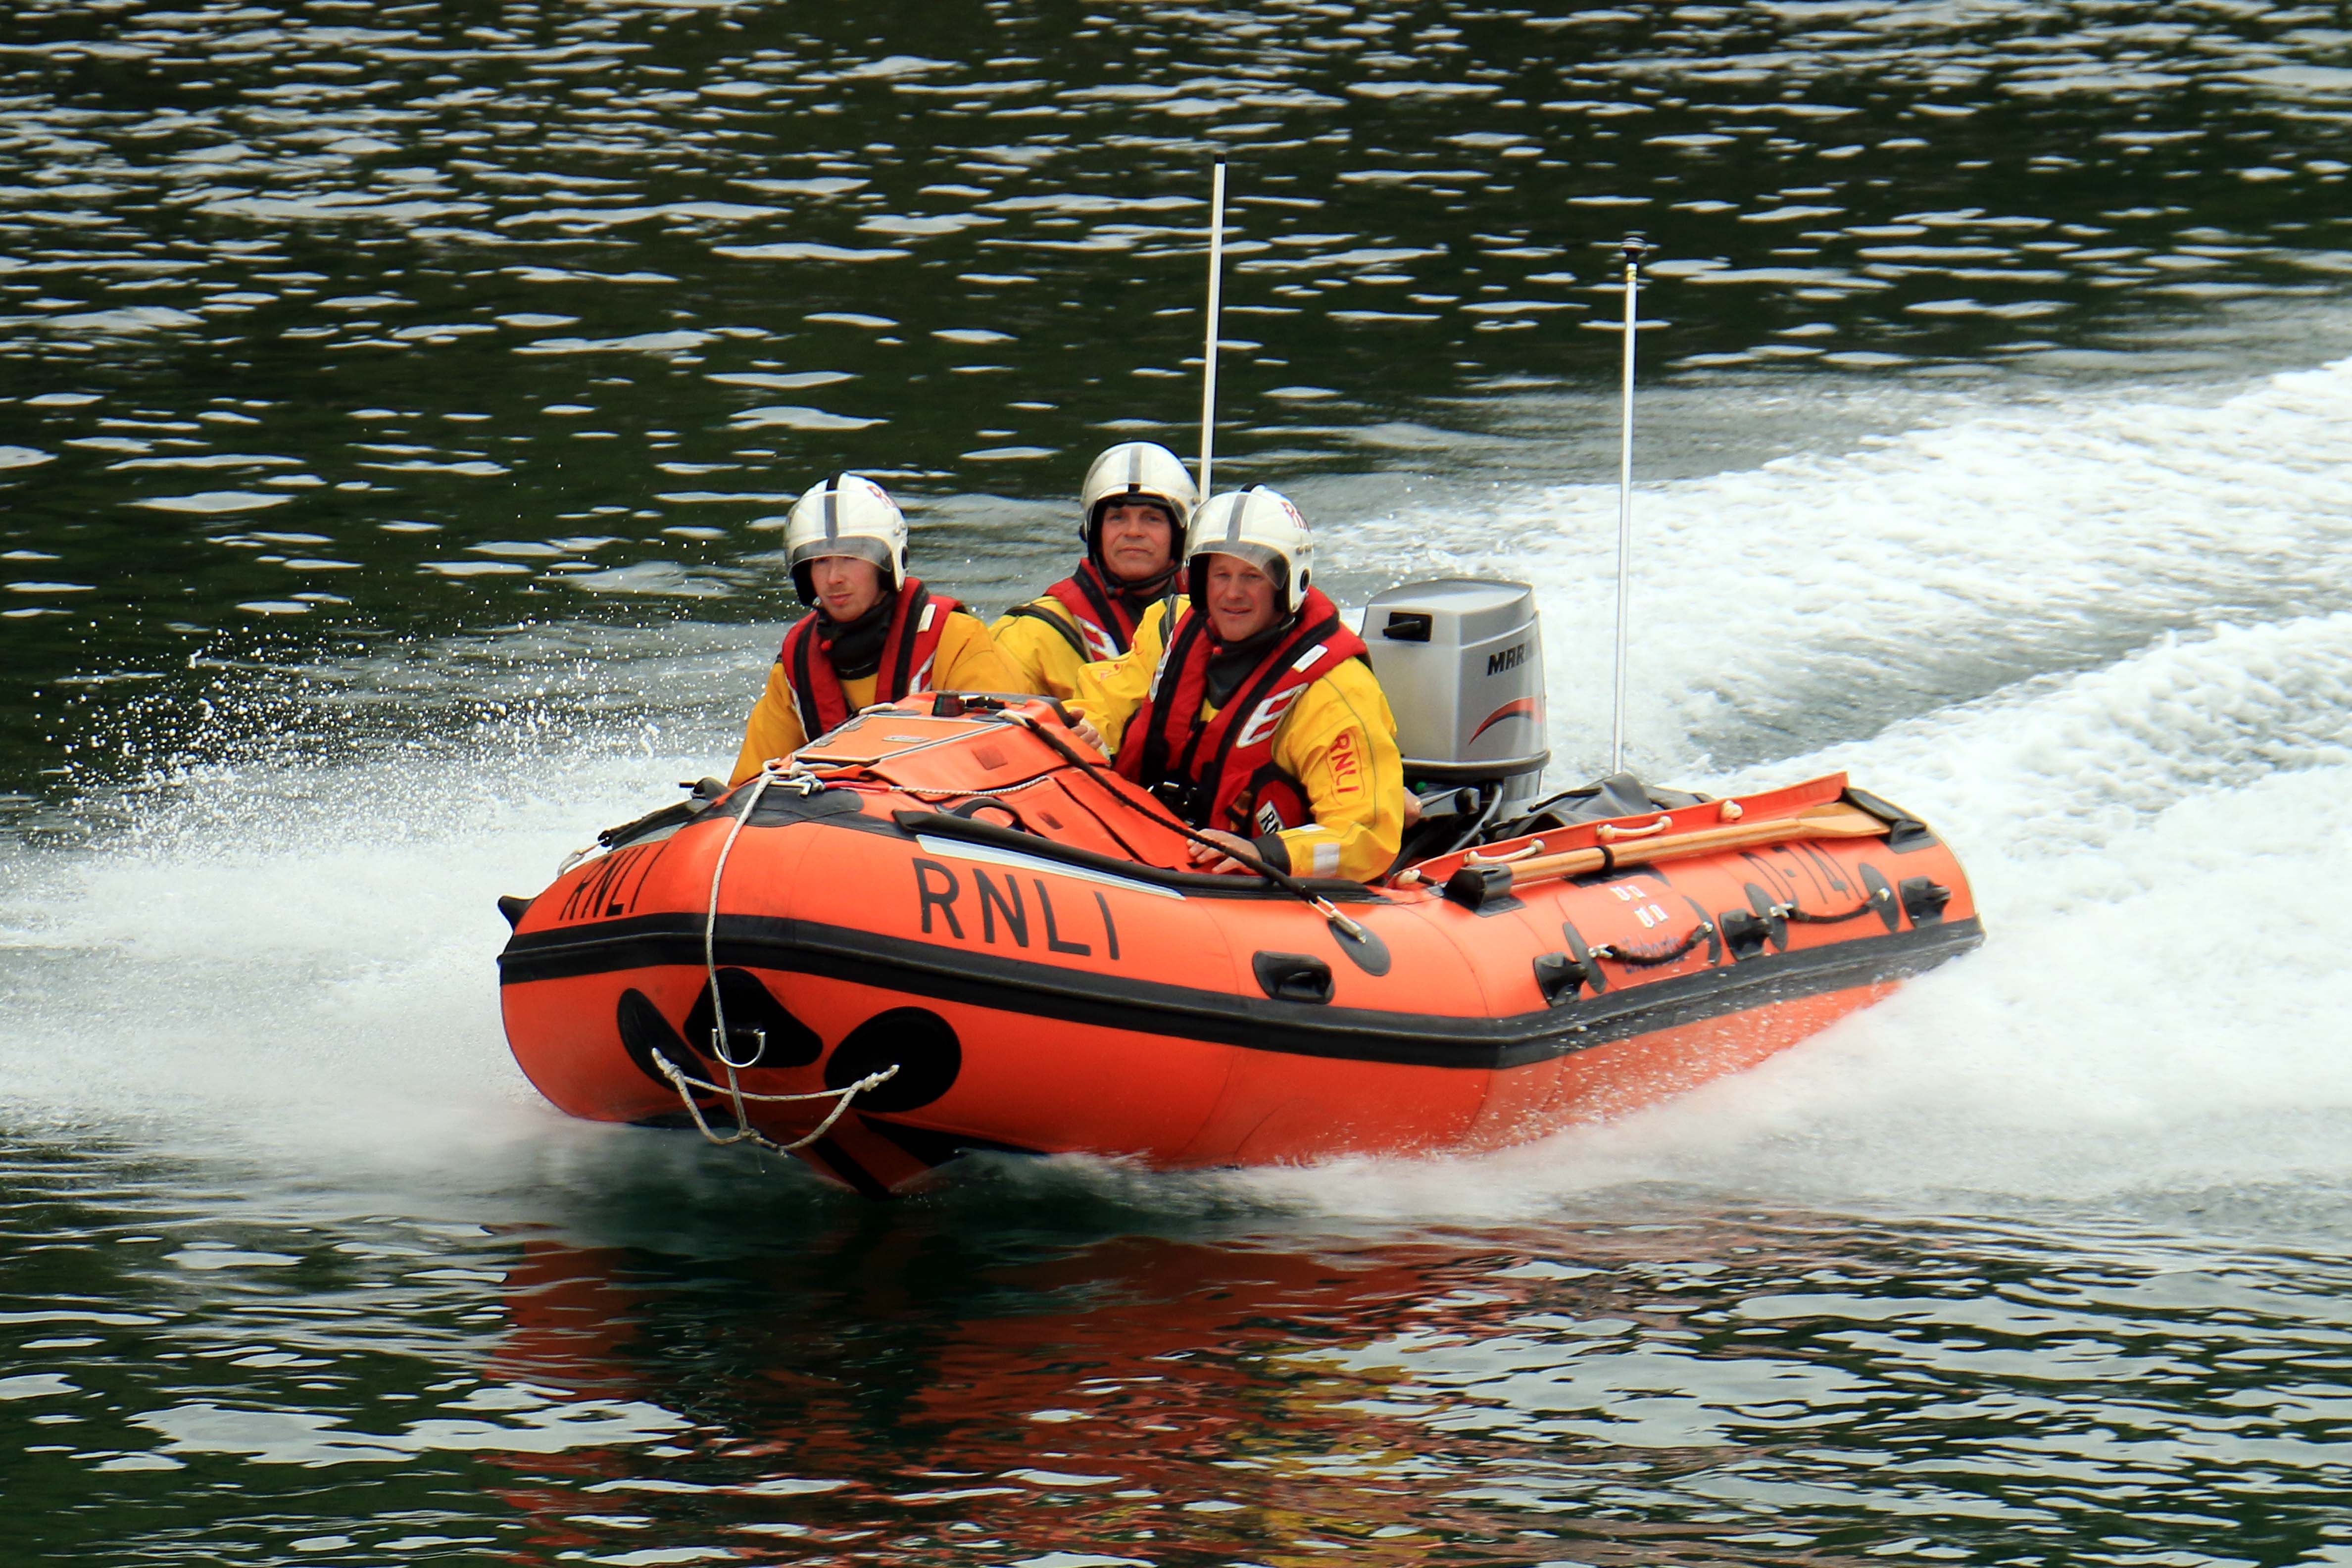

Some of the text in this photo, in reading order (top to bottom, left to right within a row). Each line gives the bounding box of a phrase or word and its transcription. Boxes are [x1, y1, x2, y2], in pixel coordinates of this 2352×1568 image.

[1330, 734, 1359, 793] RNLI
[559, 842, 669, 921] RNLI
[912, 857, 1121, 961] RNLI
